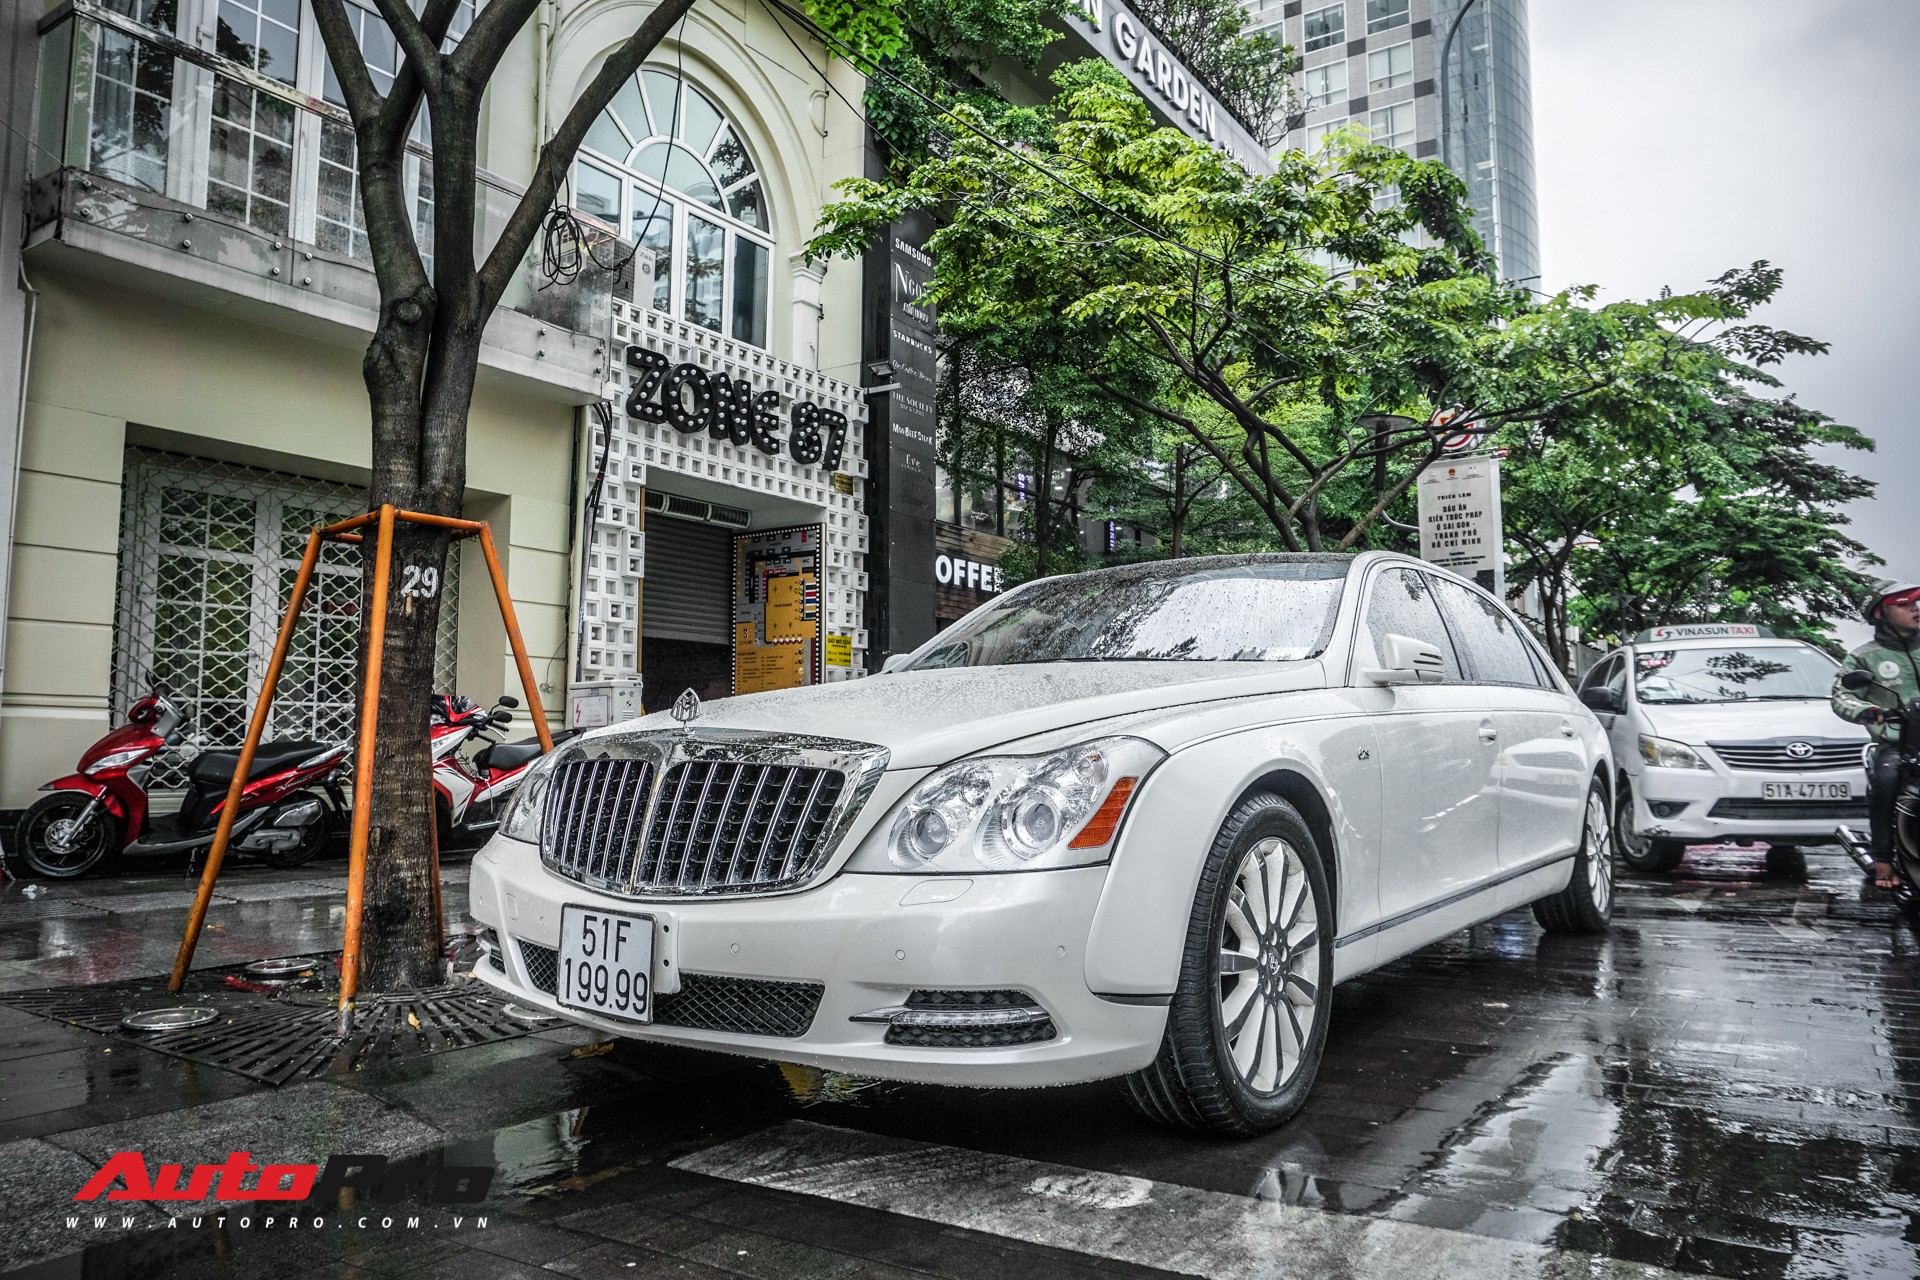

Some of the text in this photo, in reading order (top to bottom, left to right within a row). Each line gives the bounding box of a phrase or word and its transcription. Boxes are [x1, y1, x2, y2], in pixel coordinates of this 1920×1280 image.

[1111, 11, 1216, 141] GARDEN
[895, 237, 932, 267] SAMSUNG
[893, 329, 933, 354] STARBUCKS
[626, 345, 848, 472] ZONE 87
[892, 390, 934, 414] THE SOCIETY
[400, 565, 439, 598] 29
[1676, 626, 1755, 636] VINASUN TAXI
[582, 914, 632, 962] 51F
[564, 957, 649, 1015] 199.99
